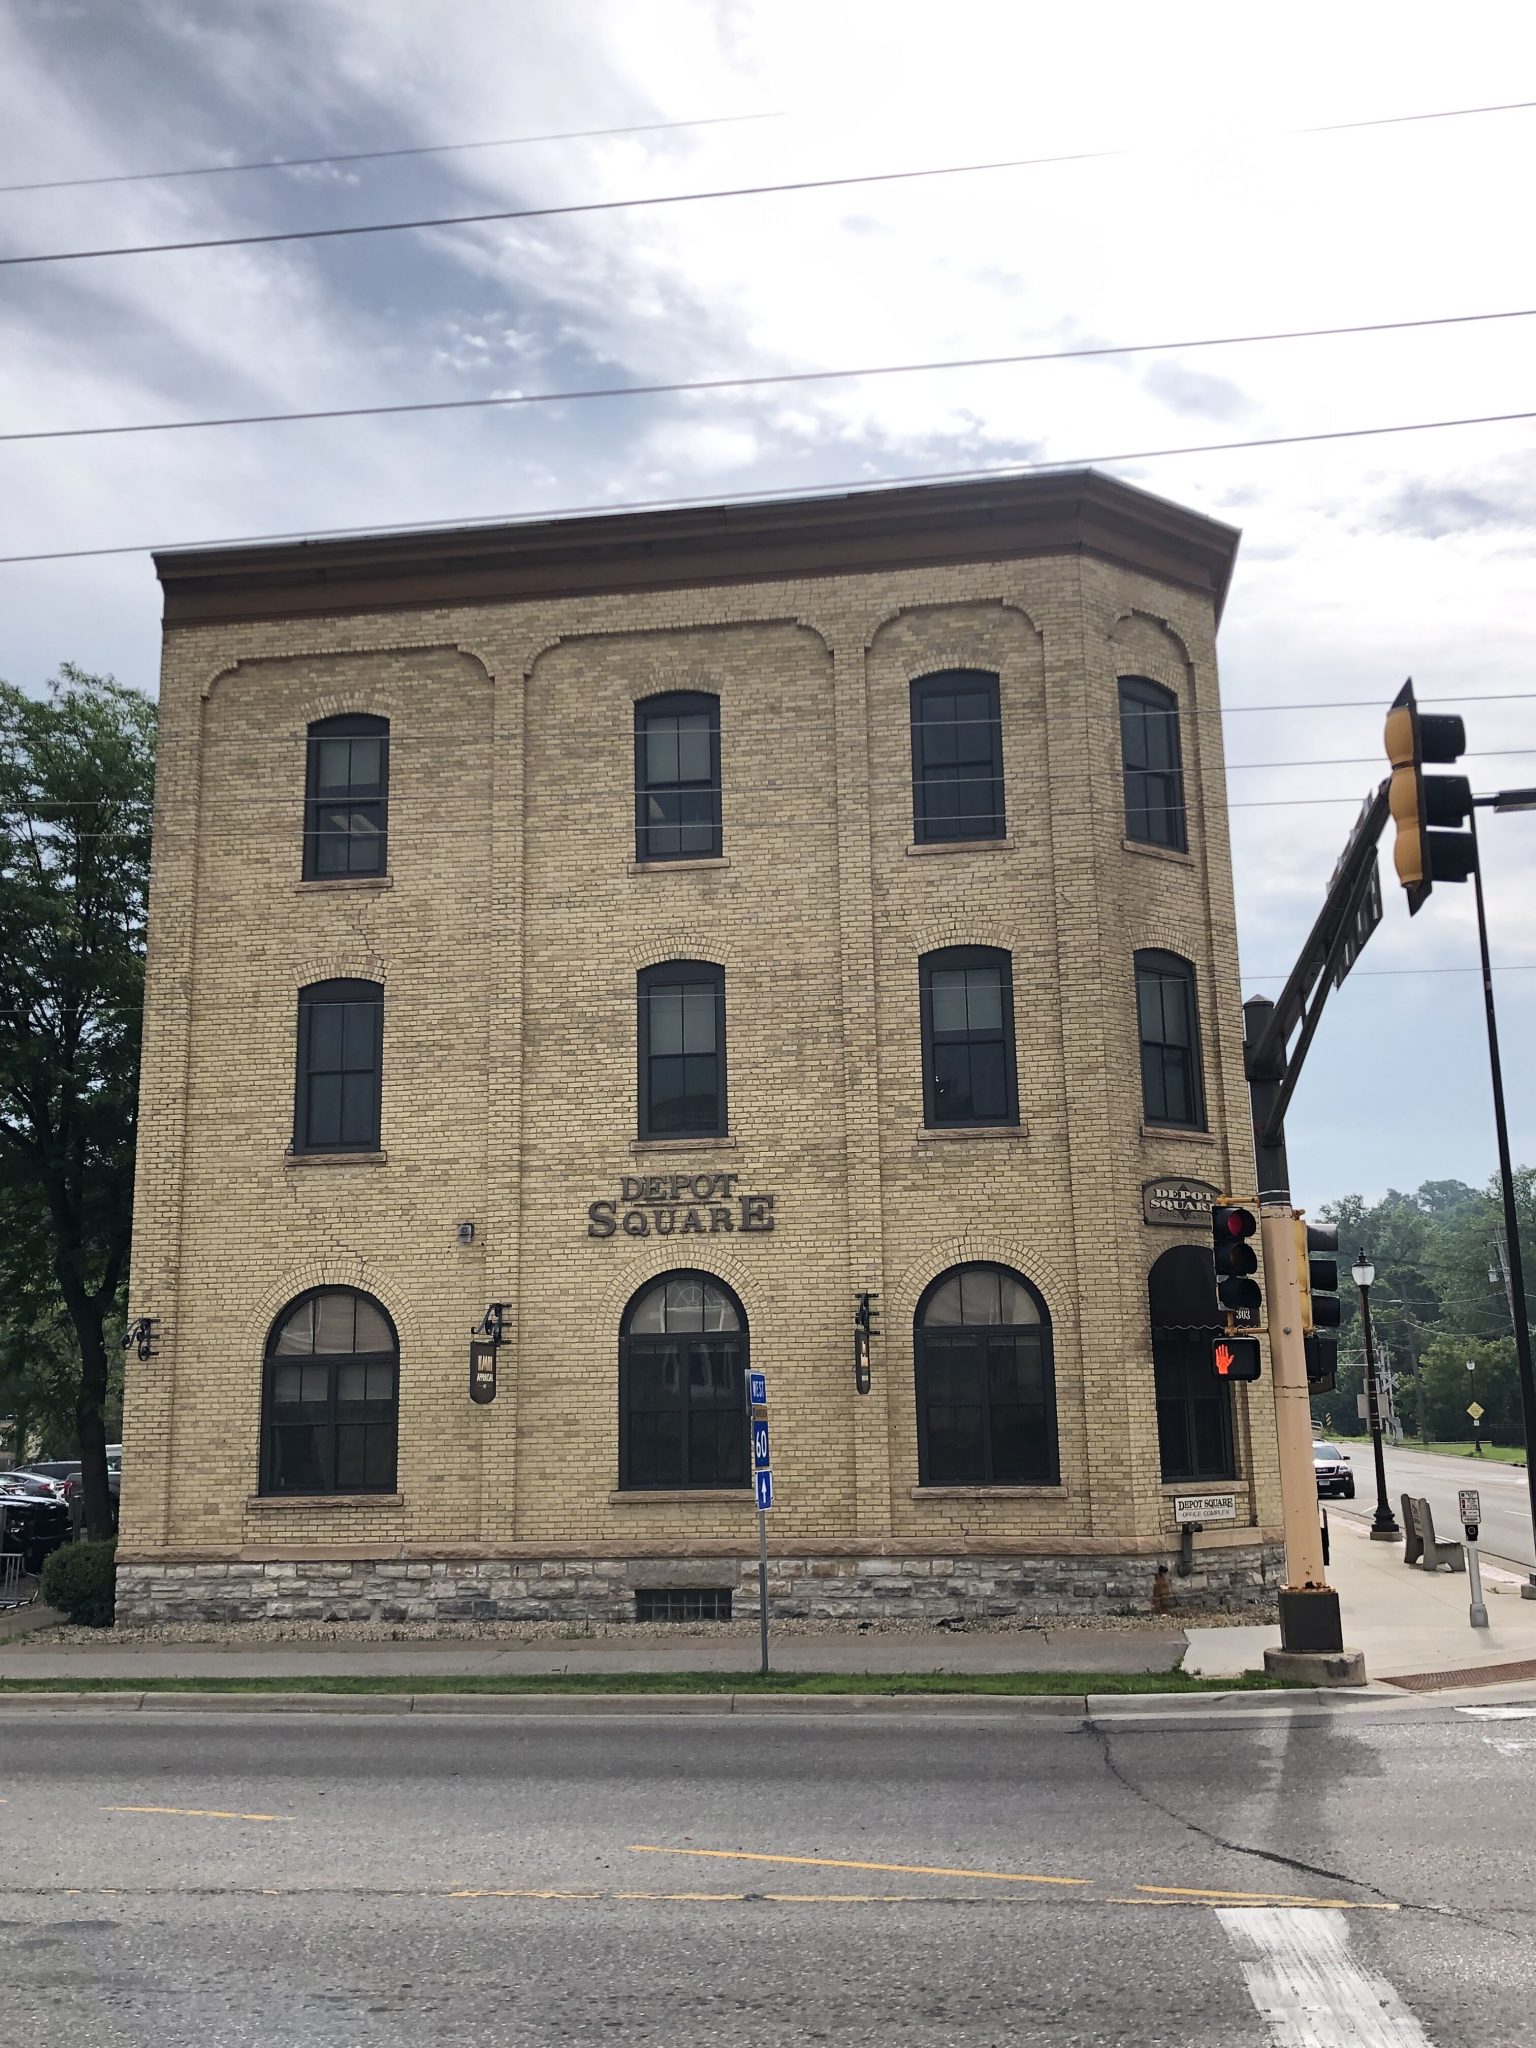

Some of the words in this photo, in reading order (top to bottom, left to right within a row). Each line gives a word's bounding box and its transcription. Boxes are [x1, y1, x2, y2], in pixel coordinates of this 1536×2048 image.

[620, 1173, 738, 1201] DEPOT
[1155, 1188, 1214, 1201] DEPOT
[588, 1195, 775, 1237] SQUARE
[1236, 1310, 1250, 1320] 303
[752, 1380, 765, 1398] WEST
[755, 1430, 767, 1458] 60
[1178, 1500, 1203, 1511] DEPOT
[1204, 1498, 1233, 1509] SQUARE
[1203, 1509, 1230, 1517] COMPLEX
